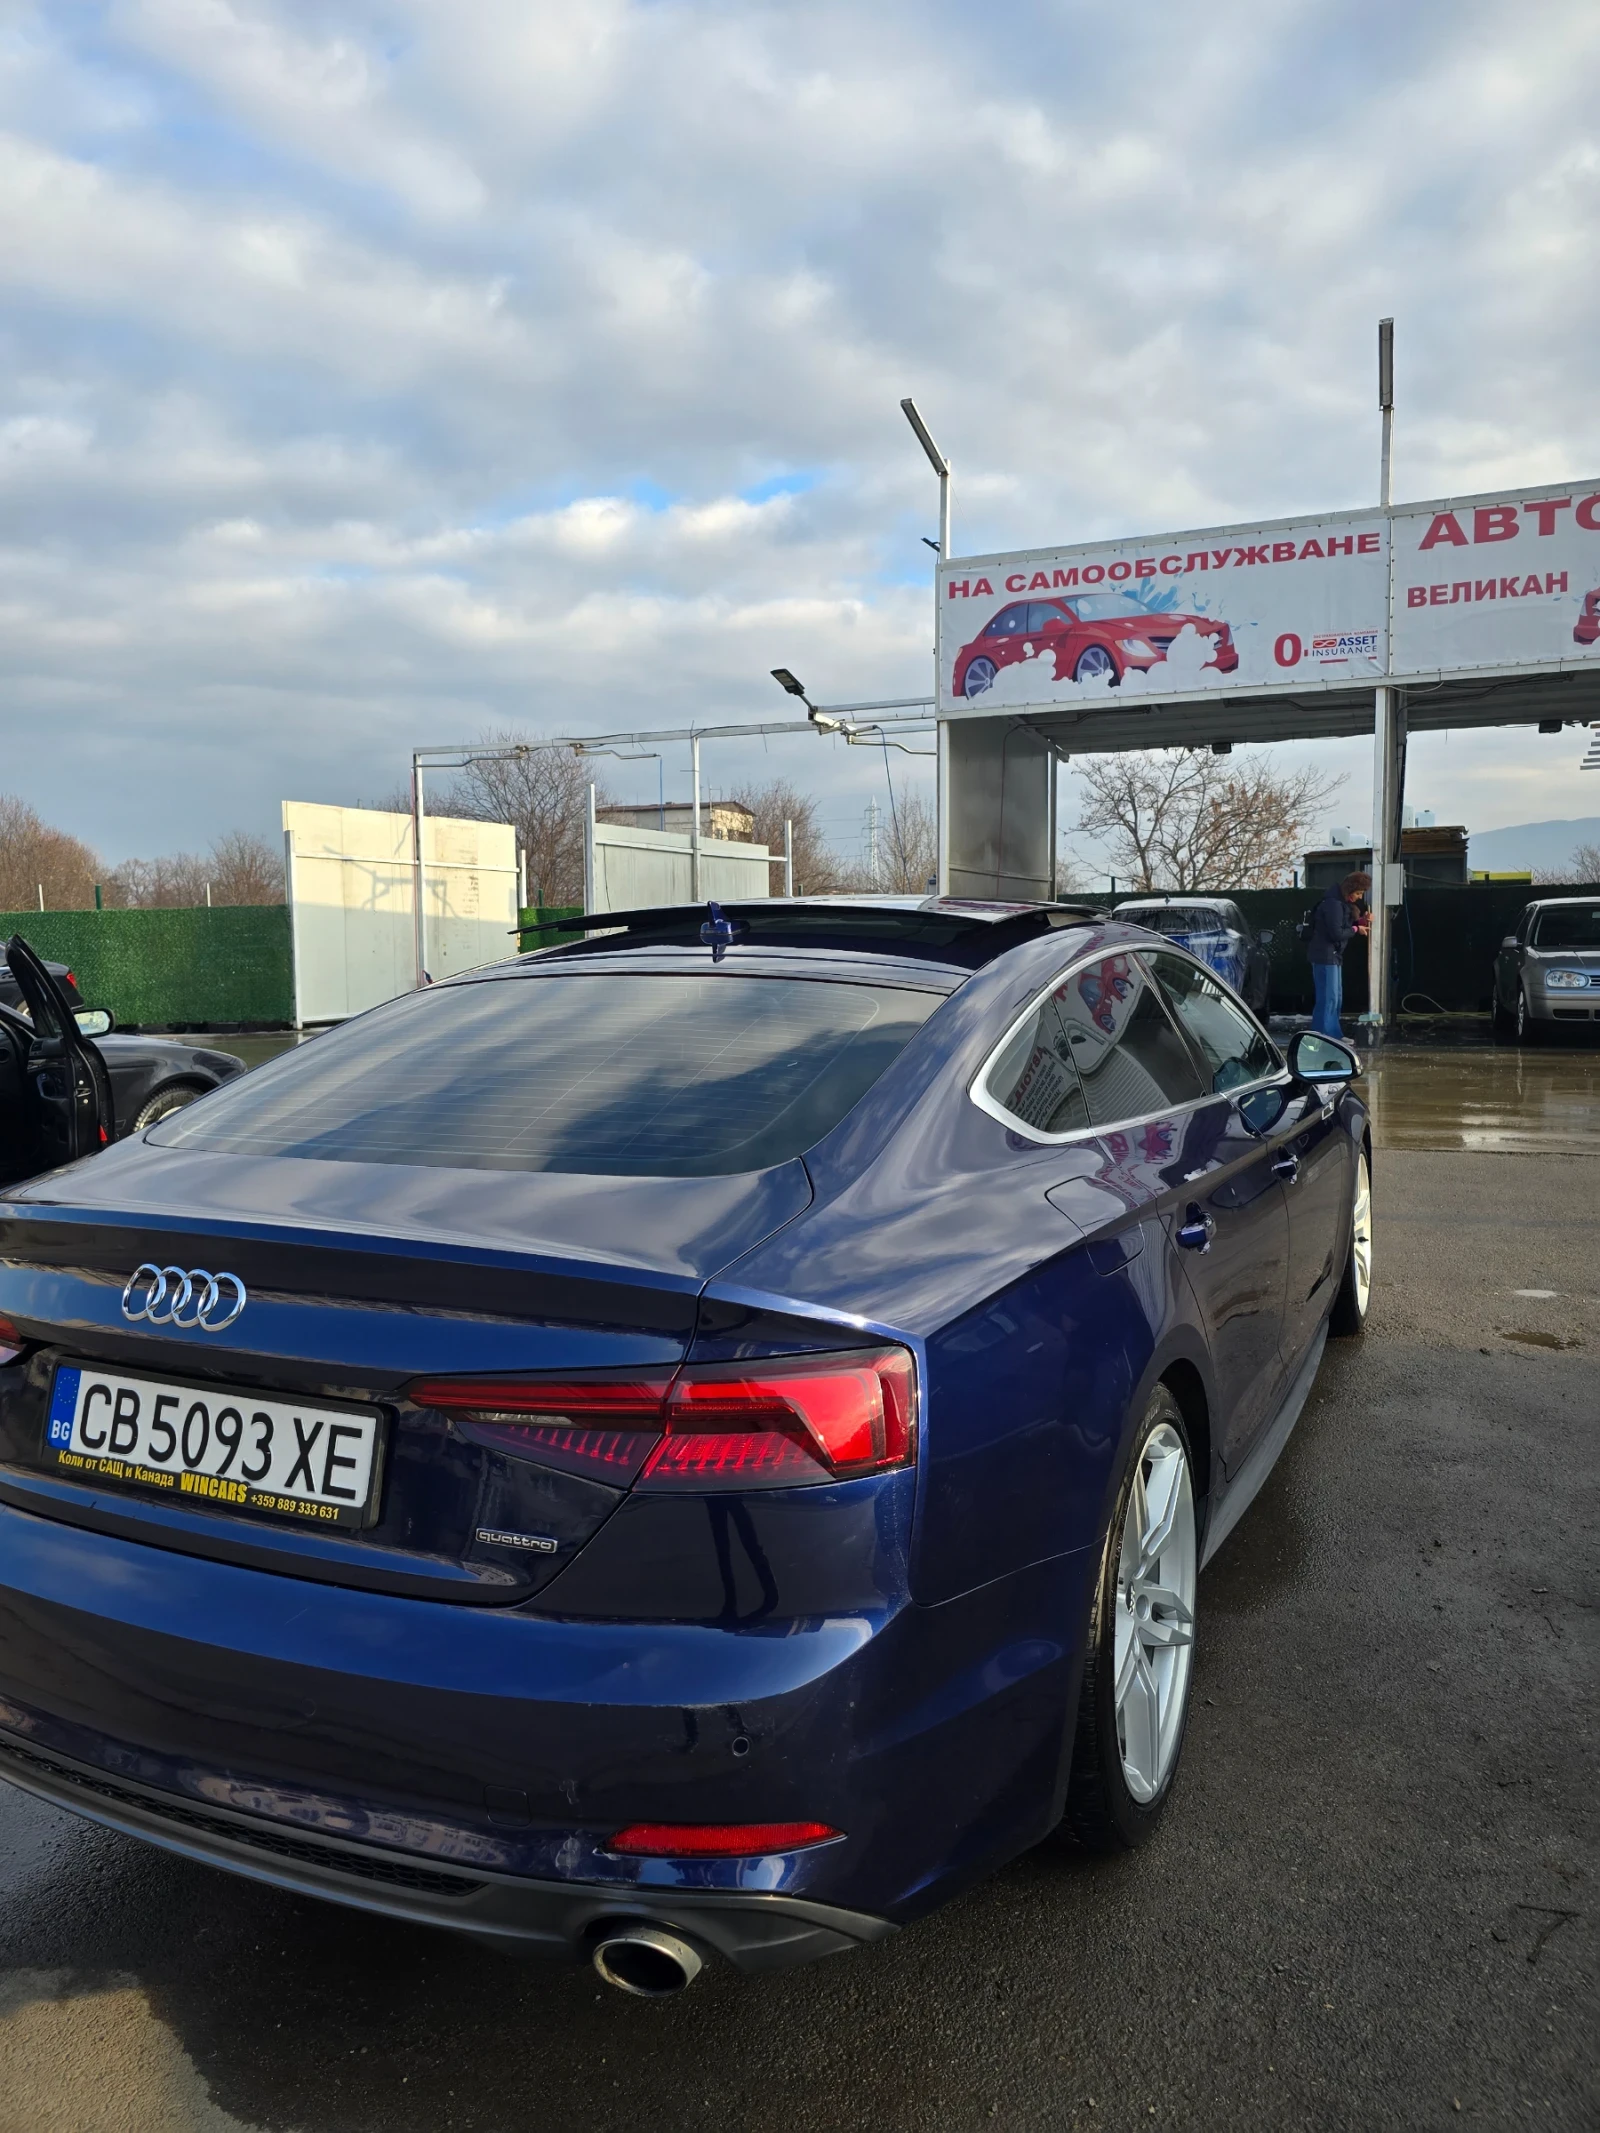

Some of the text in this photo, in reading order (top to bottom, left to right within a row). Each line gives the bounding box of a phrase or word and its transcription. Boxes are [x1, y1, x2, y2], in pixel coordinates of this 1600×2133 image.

[949, 533, 1380, 599] НА САМООБСЛУЖВАНЕ
[1407, 571, 1568, 608] ВЕЛИКАН
[1312, 645, 1377, 657] INSURANCE
[1338, 635, 1378, 647] ASSET
[51, 1420, 71, 1441] BG
[58, 1450, 340, 1520] Коли от САЩ и Канада WINCARS +359 889 333 631
[479, 1531, 552, 1550] quattro
